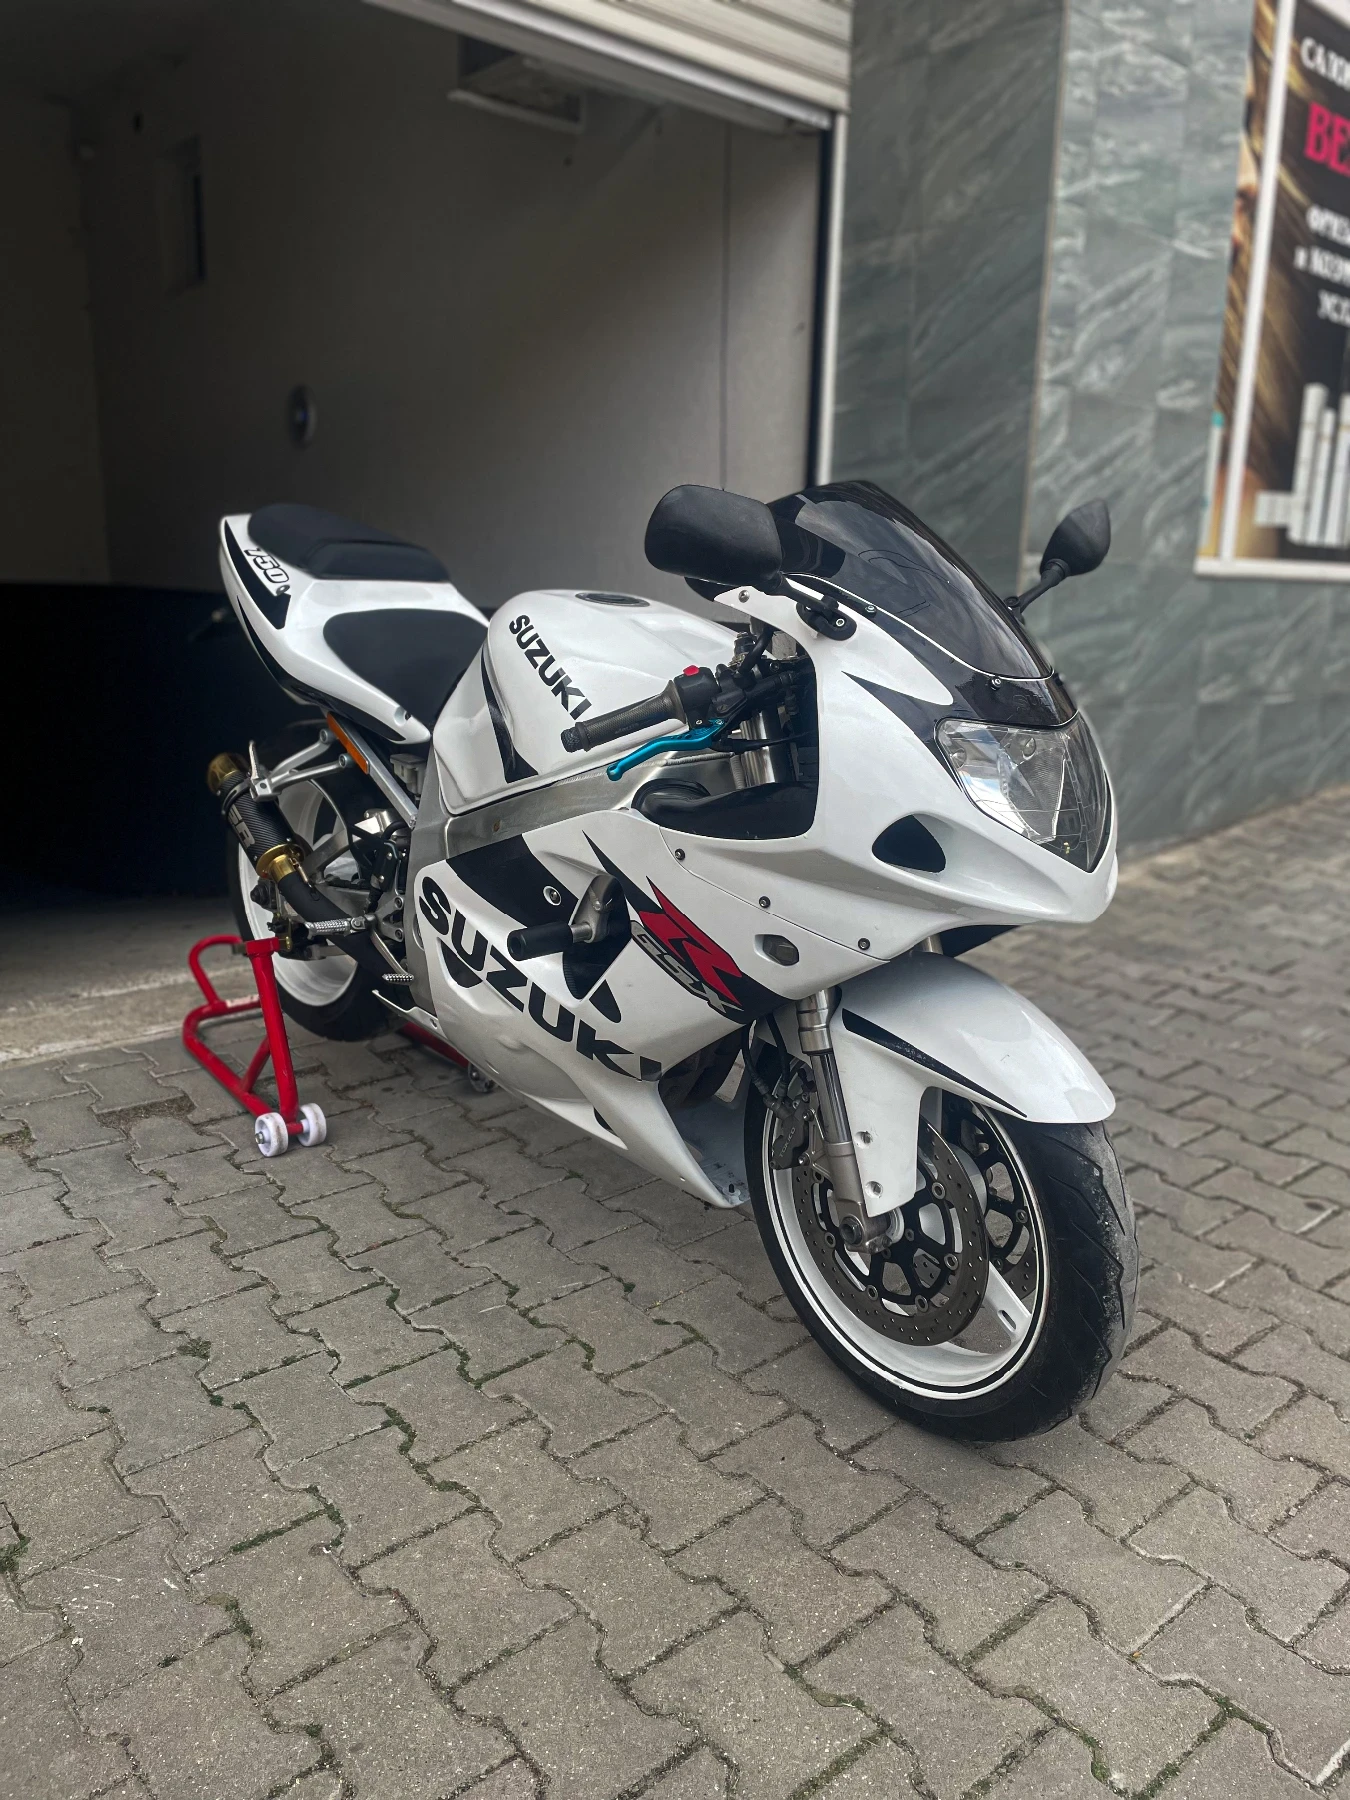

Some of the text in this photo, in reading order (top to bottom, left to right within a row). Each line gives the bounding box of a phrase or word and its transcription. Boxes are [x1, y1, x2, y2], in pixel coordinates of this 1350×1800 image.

[244, 547, 290, 584] 750
[508, 614, 592, 720] SUZUKI
[418, 876, 662, 1081] SUZUKI
[779, 1126, 796, 1157] TOKICO
